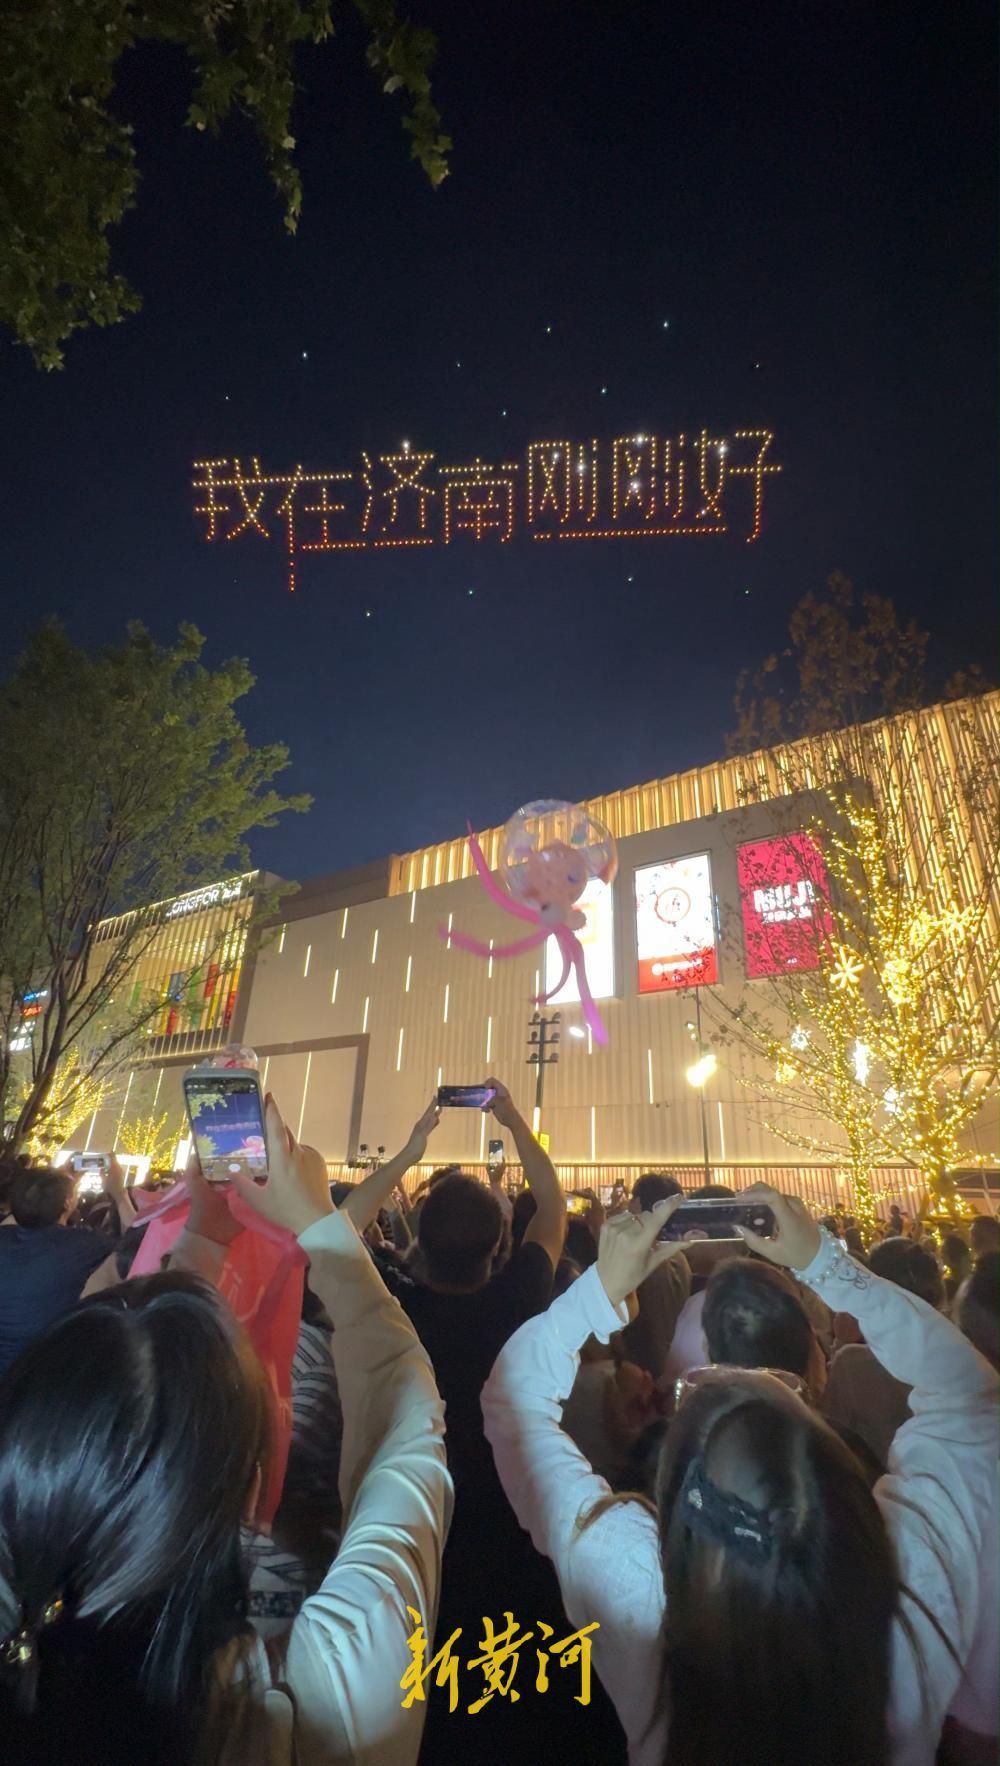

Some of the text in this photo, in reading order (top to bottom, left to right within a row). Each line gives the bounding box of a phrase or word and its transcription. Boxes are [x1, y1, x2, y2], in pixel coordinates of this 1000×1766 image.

[193, 428, 783, 592] 我在济南刚刚好
[165, 889, 220, 917] ONGFOR
